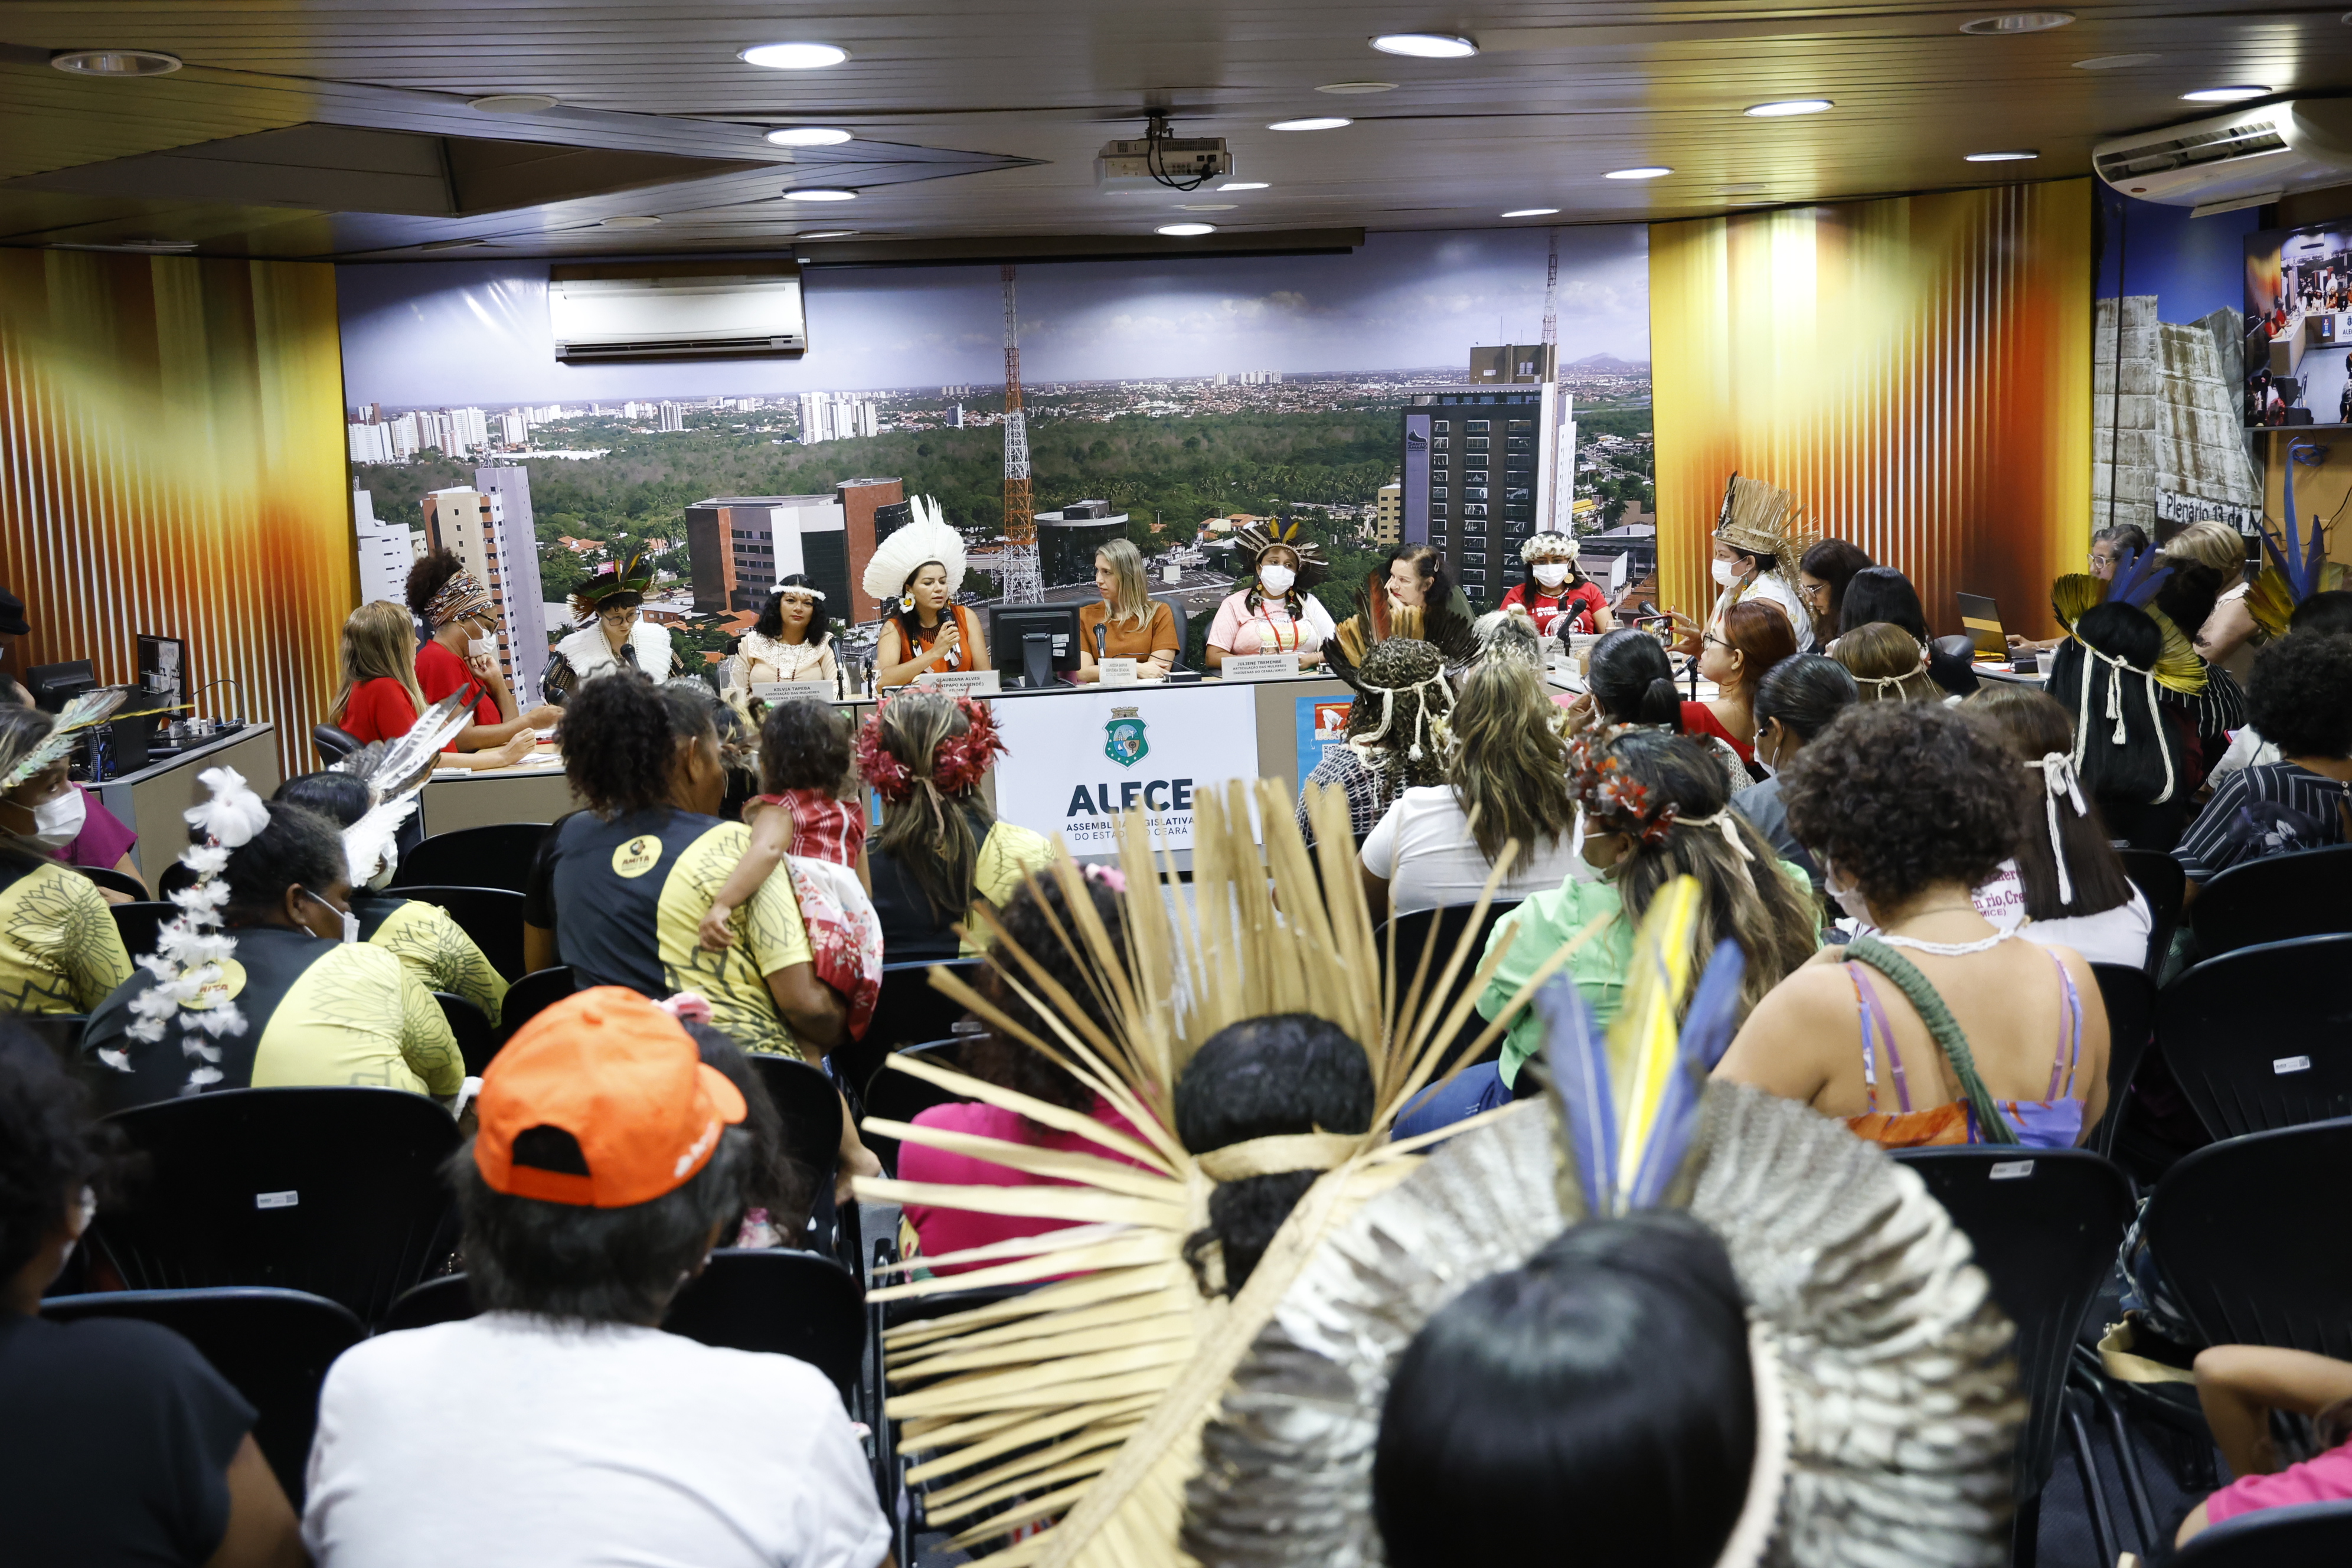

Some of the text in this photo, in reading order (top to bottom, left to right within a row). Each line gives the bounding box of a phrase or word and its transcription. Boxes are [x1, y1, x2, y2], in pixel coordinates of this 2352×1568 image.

[1066, 779, 1194, 817] ALECE
[1075, 832, 1089, 841] DO
[1154, 825, 1188, 836] CEARÁ
